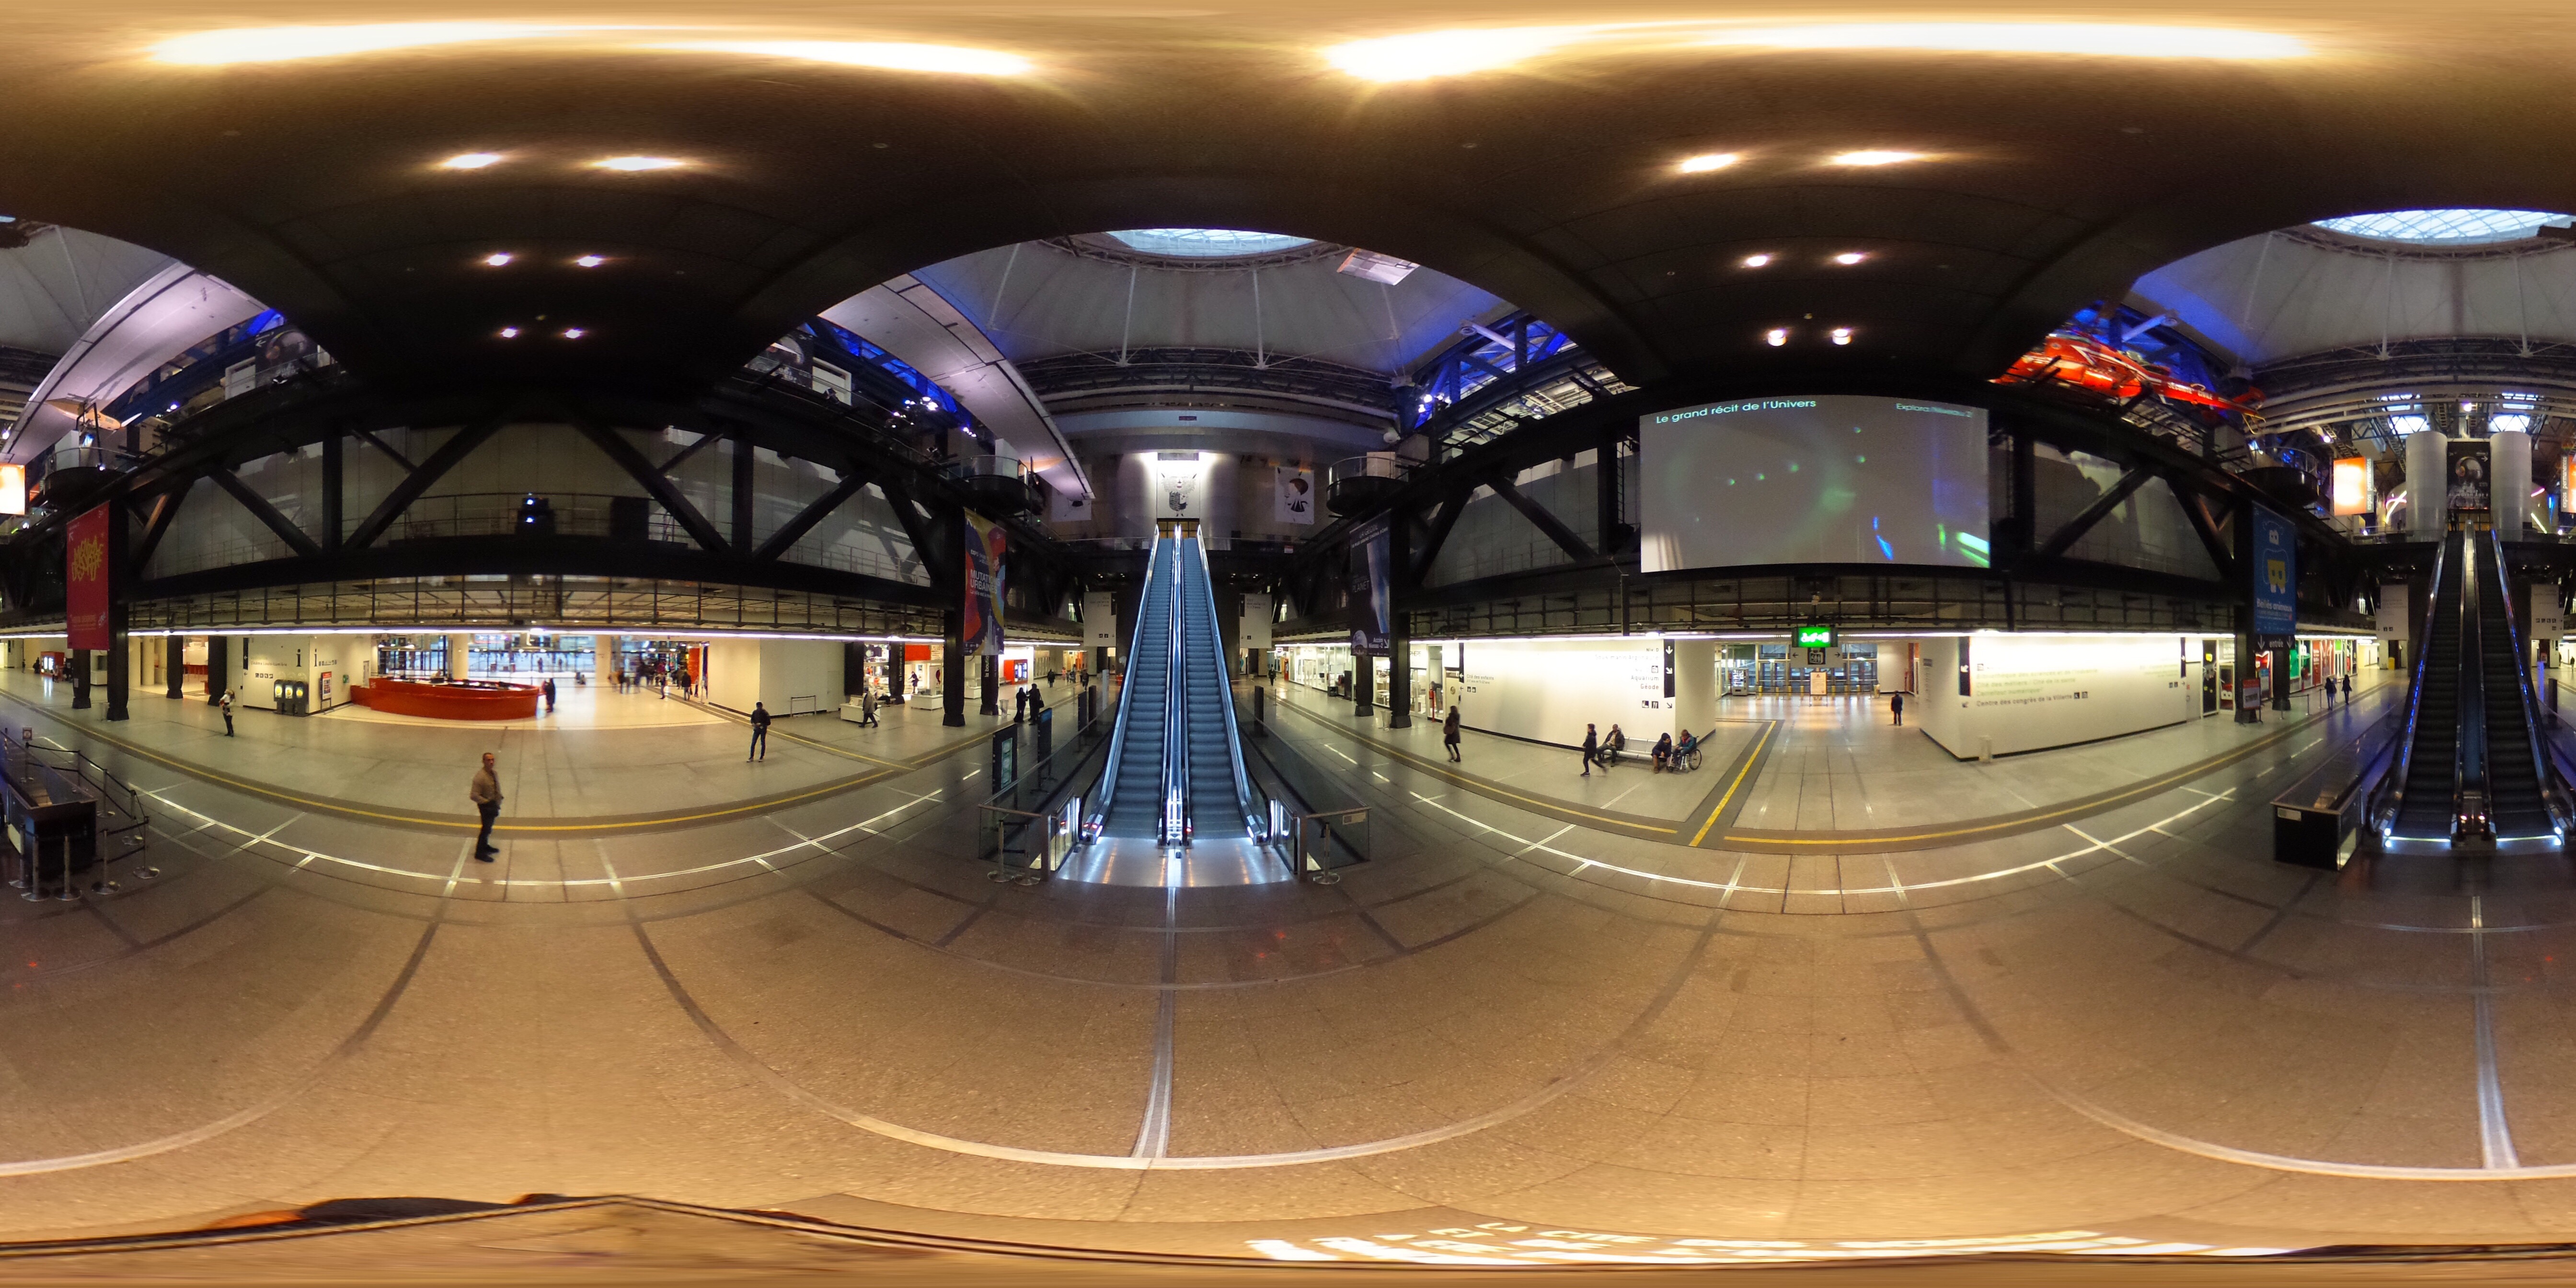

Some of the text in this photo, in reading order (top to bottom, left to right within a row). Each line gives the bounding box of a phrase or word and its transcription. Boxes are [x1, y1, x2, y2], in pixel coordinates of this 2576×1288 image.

[1656, 415, 1668, 424] Le
[1672, 408, 1708, 422] grand
[1711, 405, 1738, 414] récit
[1742, 402, 1759, 411] de
[970, 569, 1000, 586] MUTATIONS
[970, 578, 997, 594] URBAINES
